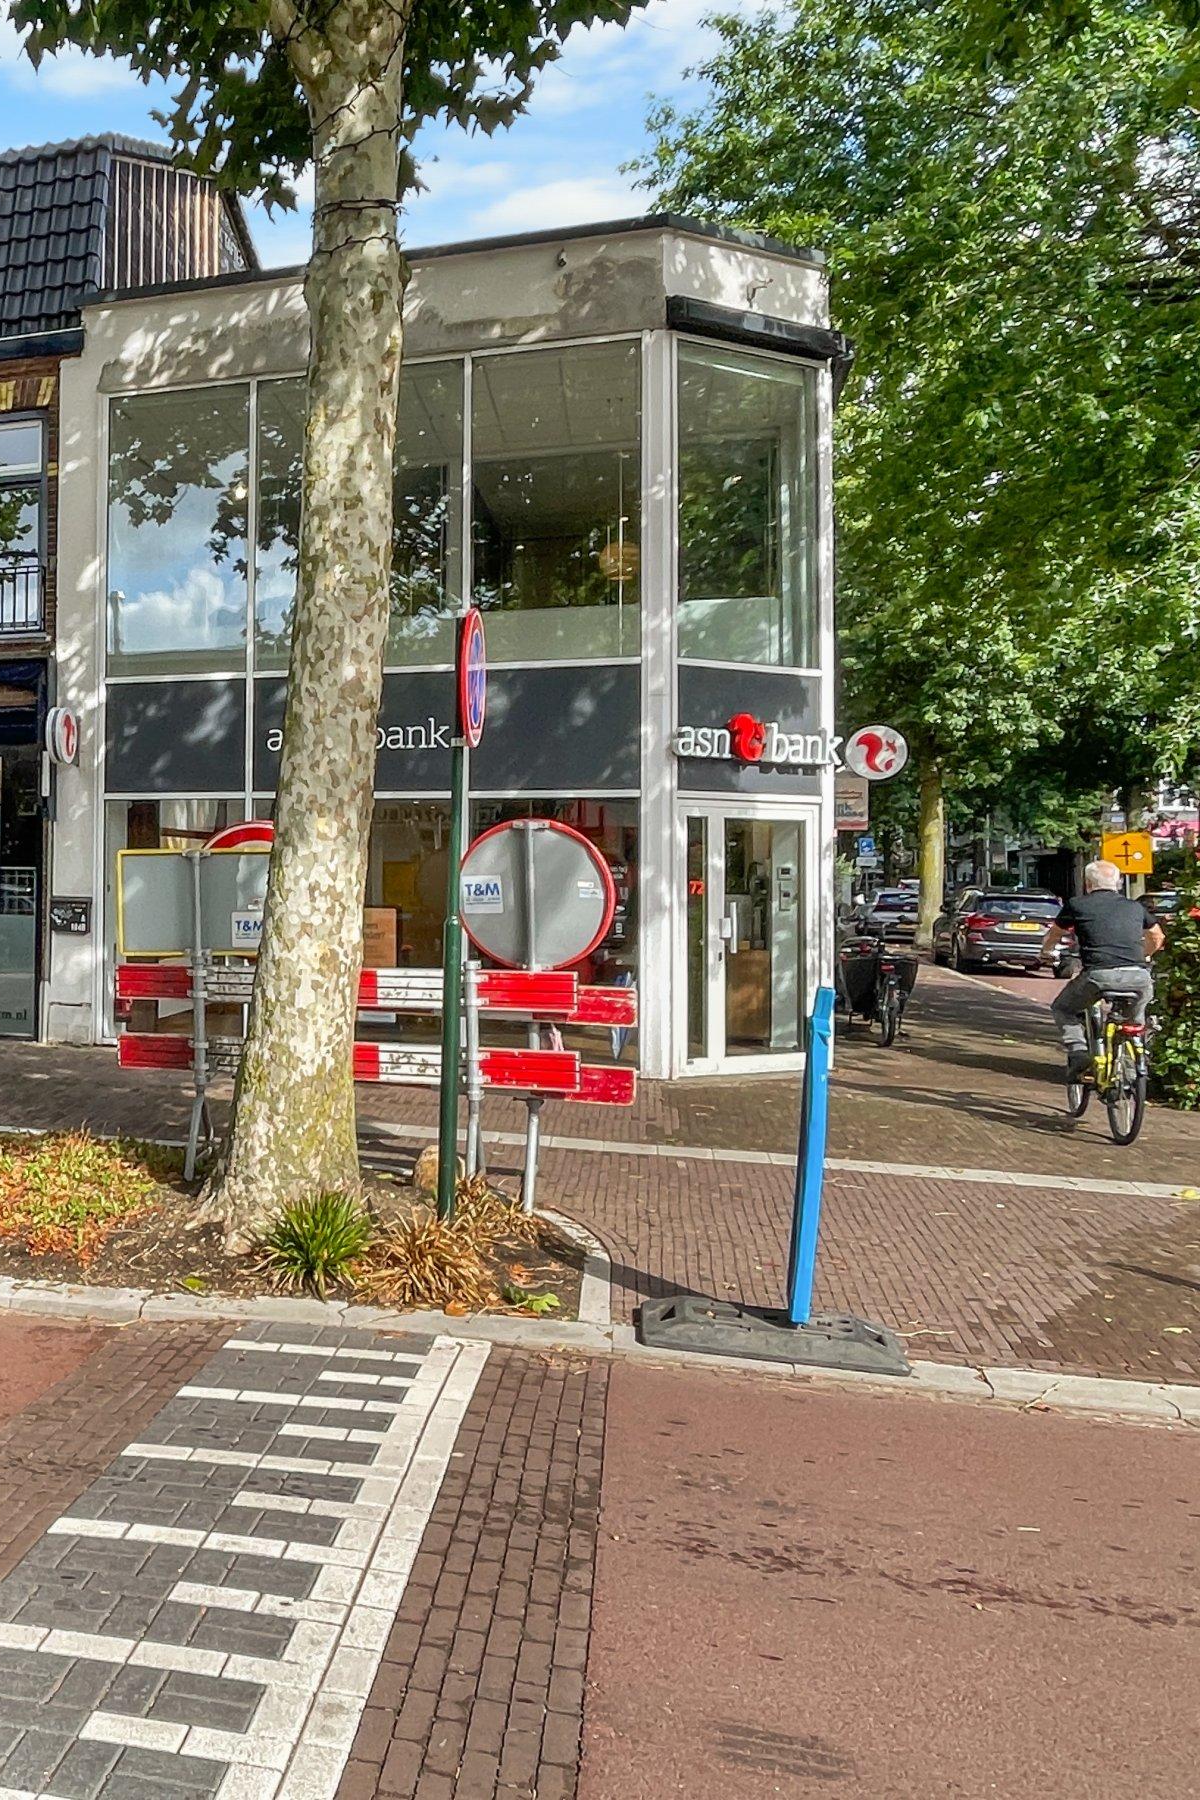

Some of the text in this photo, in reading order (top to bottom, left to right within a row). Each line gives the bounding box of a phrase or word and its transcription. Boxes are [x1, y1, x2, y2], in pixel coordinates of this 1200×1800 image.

[676, 722, 843, 765] asn bank
[464, 882, 500, 896] T&M
